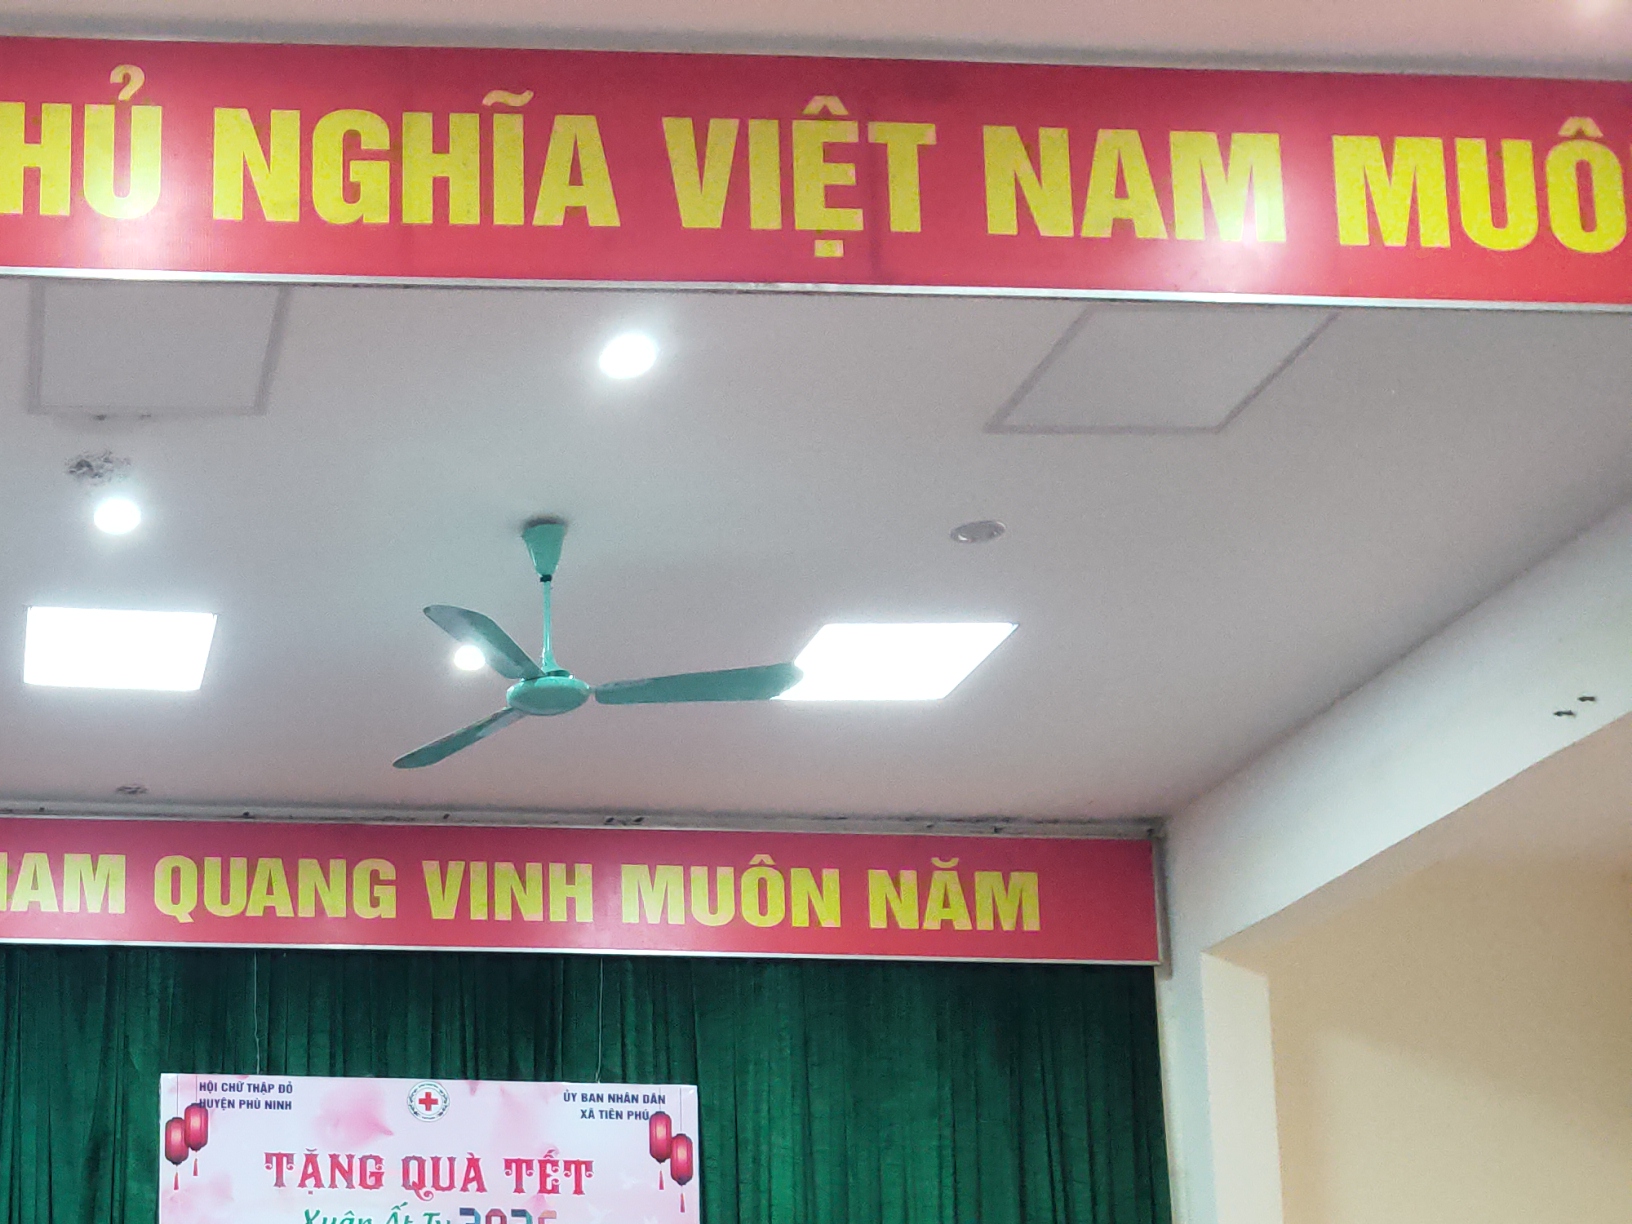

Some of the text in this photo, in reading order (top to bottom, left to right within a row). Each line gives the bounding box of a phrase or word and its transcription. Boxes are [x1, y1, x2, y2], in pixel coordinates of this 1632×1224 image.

[212, 89, 620, 227] NGHĨA
[662, 95, 937, 258] VIỆT
[982, 125, 1287, 244] NAM
[153, 854, 398, 923] QUANG
[424, 860, 593, 923] VINH
[621, 852, 841, 929] MUÔN
[867, 856, 1040, 932] NĂM
[199, 1080, 293, 1095] HỘI CHỮ THẬP ĐỎ
[199, 1097, 292, 1110] HUYỆN PHÙ NINH
[563, 1089, 666, 1105] ỦY BAN NHÂN DÂN
[580, 1108, 595, 1119] XÃ
[264, 1148, 594, 1202] TẶNG QUÀ TẾT
